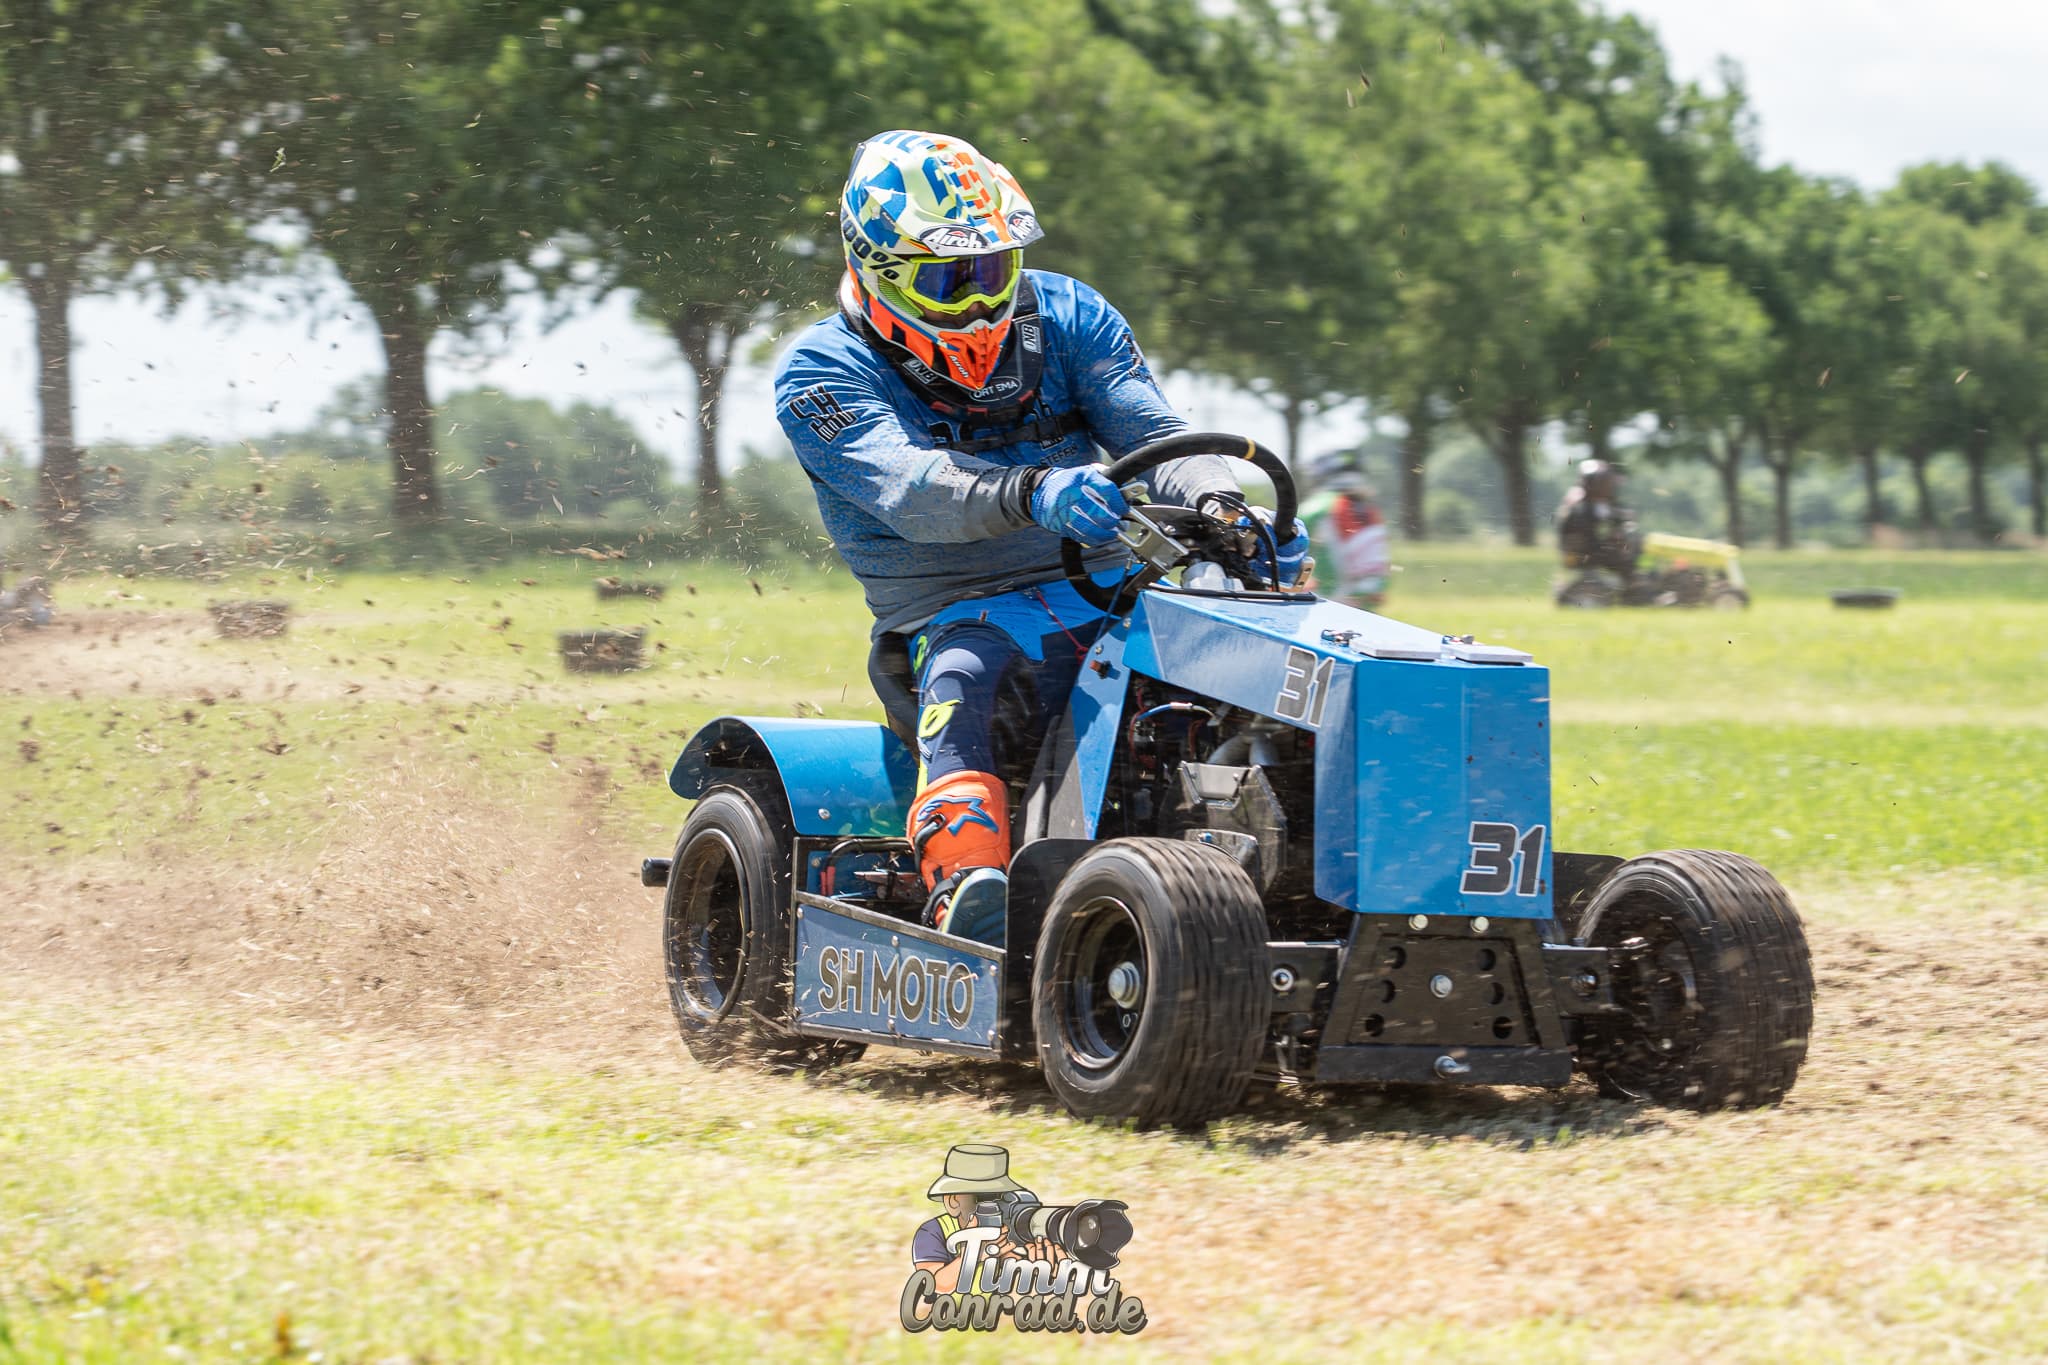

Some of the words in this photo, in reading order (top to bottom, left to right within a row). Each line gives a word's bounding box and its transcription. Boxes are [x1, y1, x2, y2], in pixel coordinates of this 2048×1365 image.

[926, 227, 984, 249] Airoh
[1008, 212, 1037, 240] Airoh
[1274, 646, 1336, 729] 31
[1459, 821, 1547, 897] 31
[818, 945, 865, 1013] SH
[870, 948, 976, 1030] MOTO
